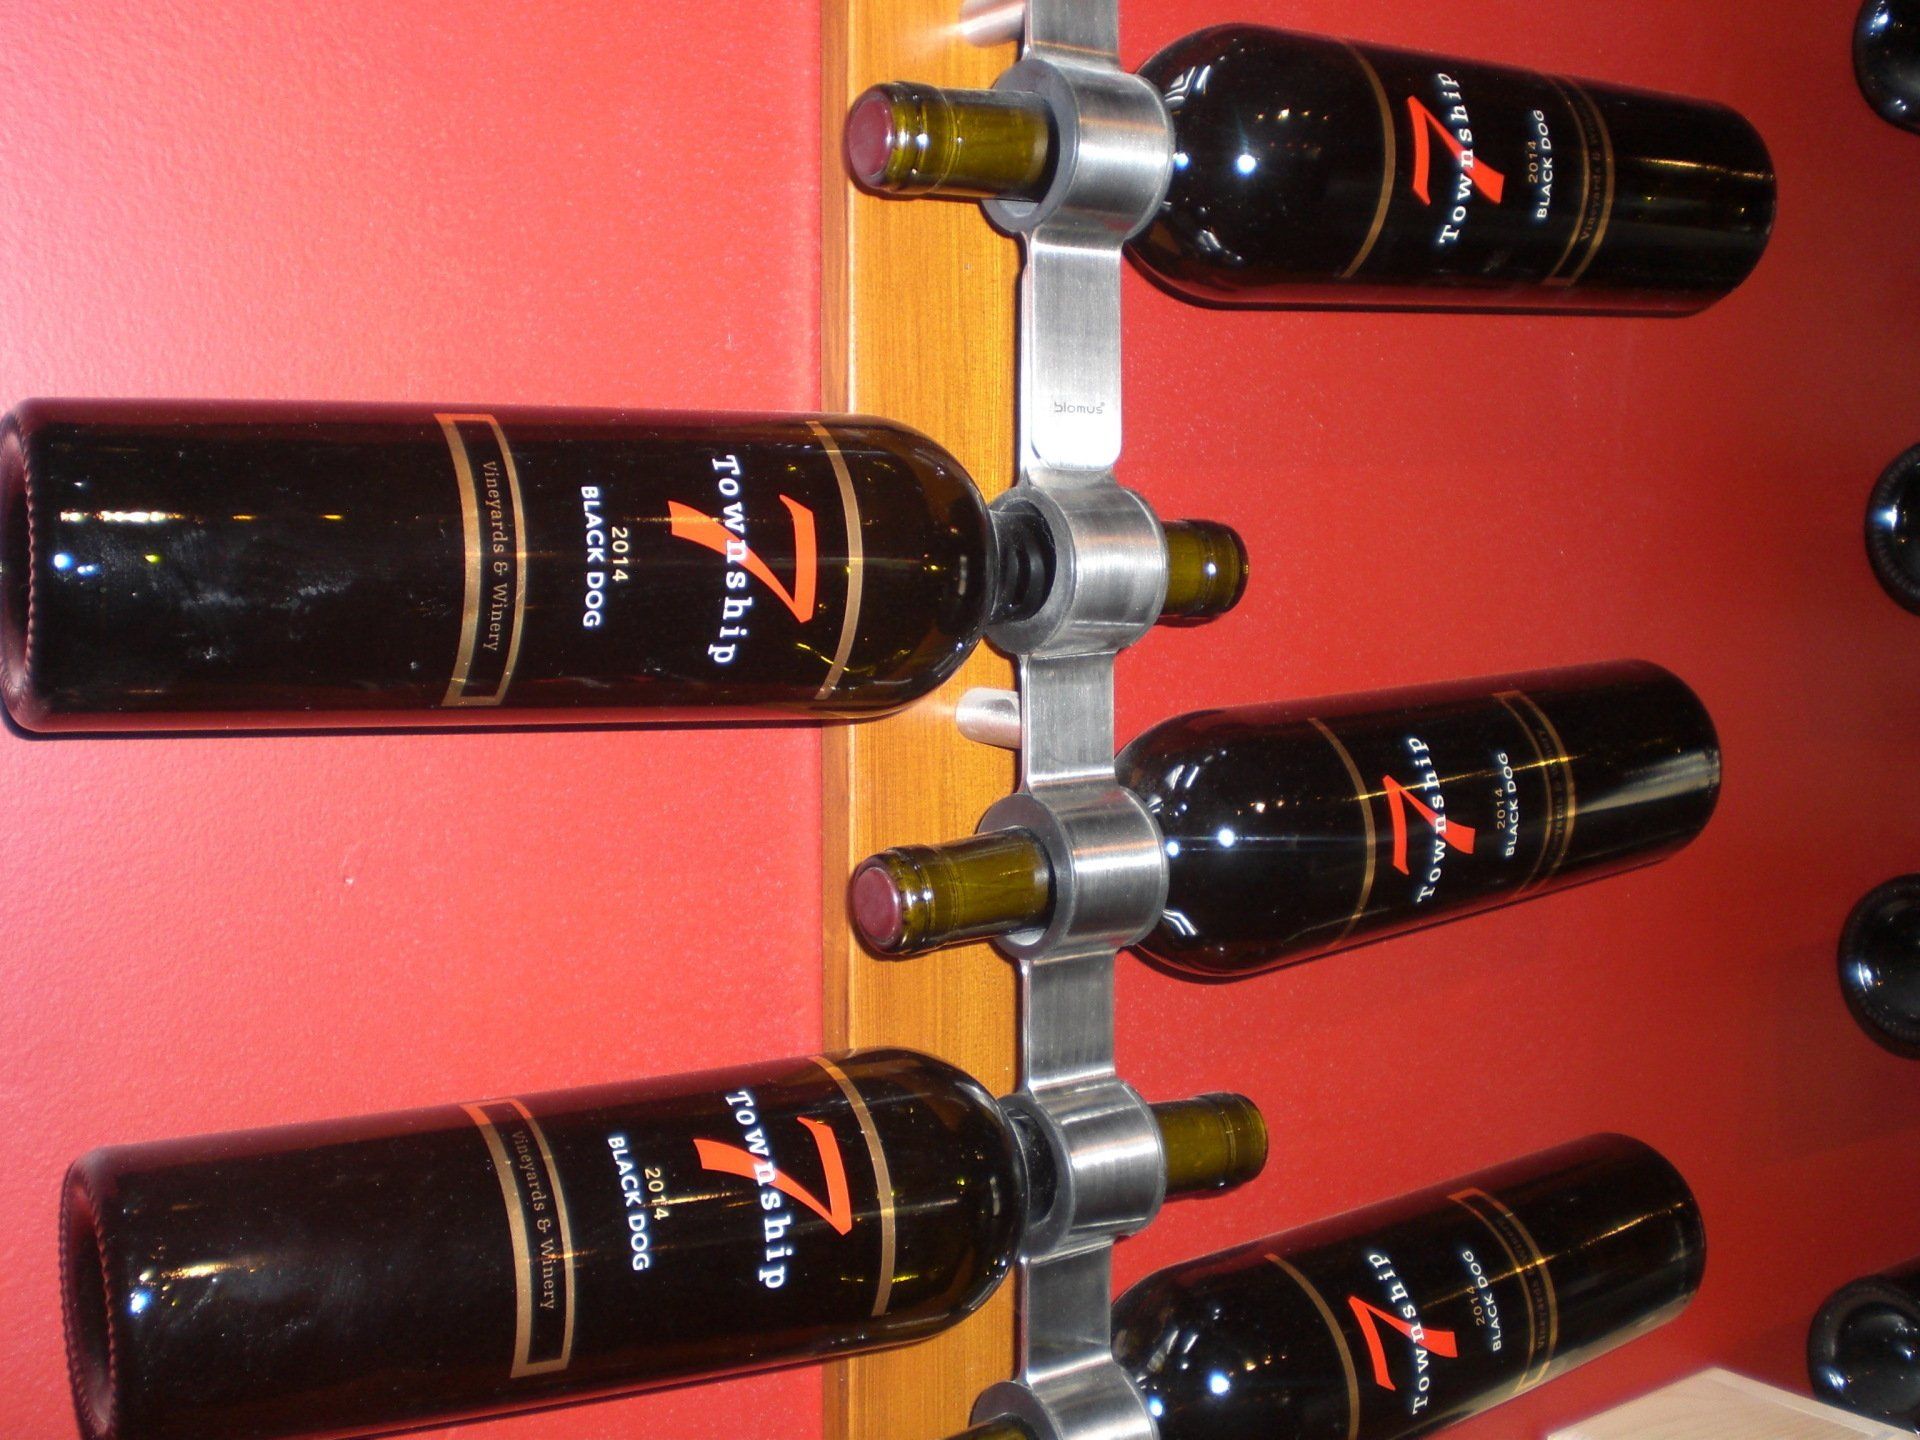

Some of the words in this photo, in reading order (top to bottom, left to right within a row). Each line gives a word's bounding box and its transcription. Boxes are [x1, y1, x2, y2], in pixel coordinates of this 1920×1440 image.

[1408, 95, 1505, 206] 7
[1437, 73, 1474, 244] Township
[1528, 141, 1538, 183] 2014
[1533, 109, 1552, 150] DOG
[1537, 157, 1553, 218] BLACK
[482, 460, 507, 555] Vineyards
[580, 485, 603, 562] BLACK
[493, 561, 508, 575] &
[611, 526, 629, 582] 2014
[667, 494, 817, 623] 7
[708, 454, 752, 664] Township
[483, 582, 508, 652] Winery
[583, 572, 605, 628] DOG
[1497, 752, 1517, 793] DOG
[1382, 774, 1476, 876] 7
[1408, 737, 1447, 903] Township
[1495, 788, 1506, 830] 2014
[1505, 798, 1519, 857] BLACK
[607, 1136, 641, 1207] BLACK
[628, 1213, 651, 1271] DOG
[644, 1167, 670, 1221] 2014
[693, 1115, 852, 1236] 7
[725, 1090, 793, 1289] Township
[536, 1218, 551, 1234] &
[1462, 1250, 1488, 1289] DOG
[1368, 1252, 1430, 1415] Township
[1466, 1285, 1485, 1326] 2014
[1483, 1292, 1502, 1352] BLACK
[1349, 1295, 1458, 1391] 7
